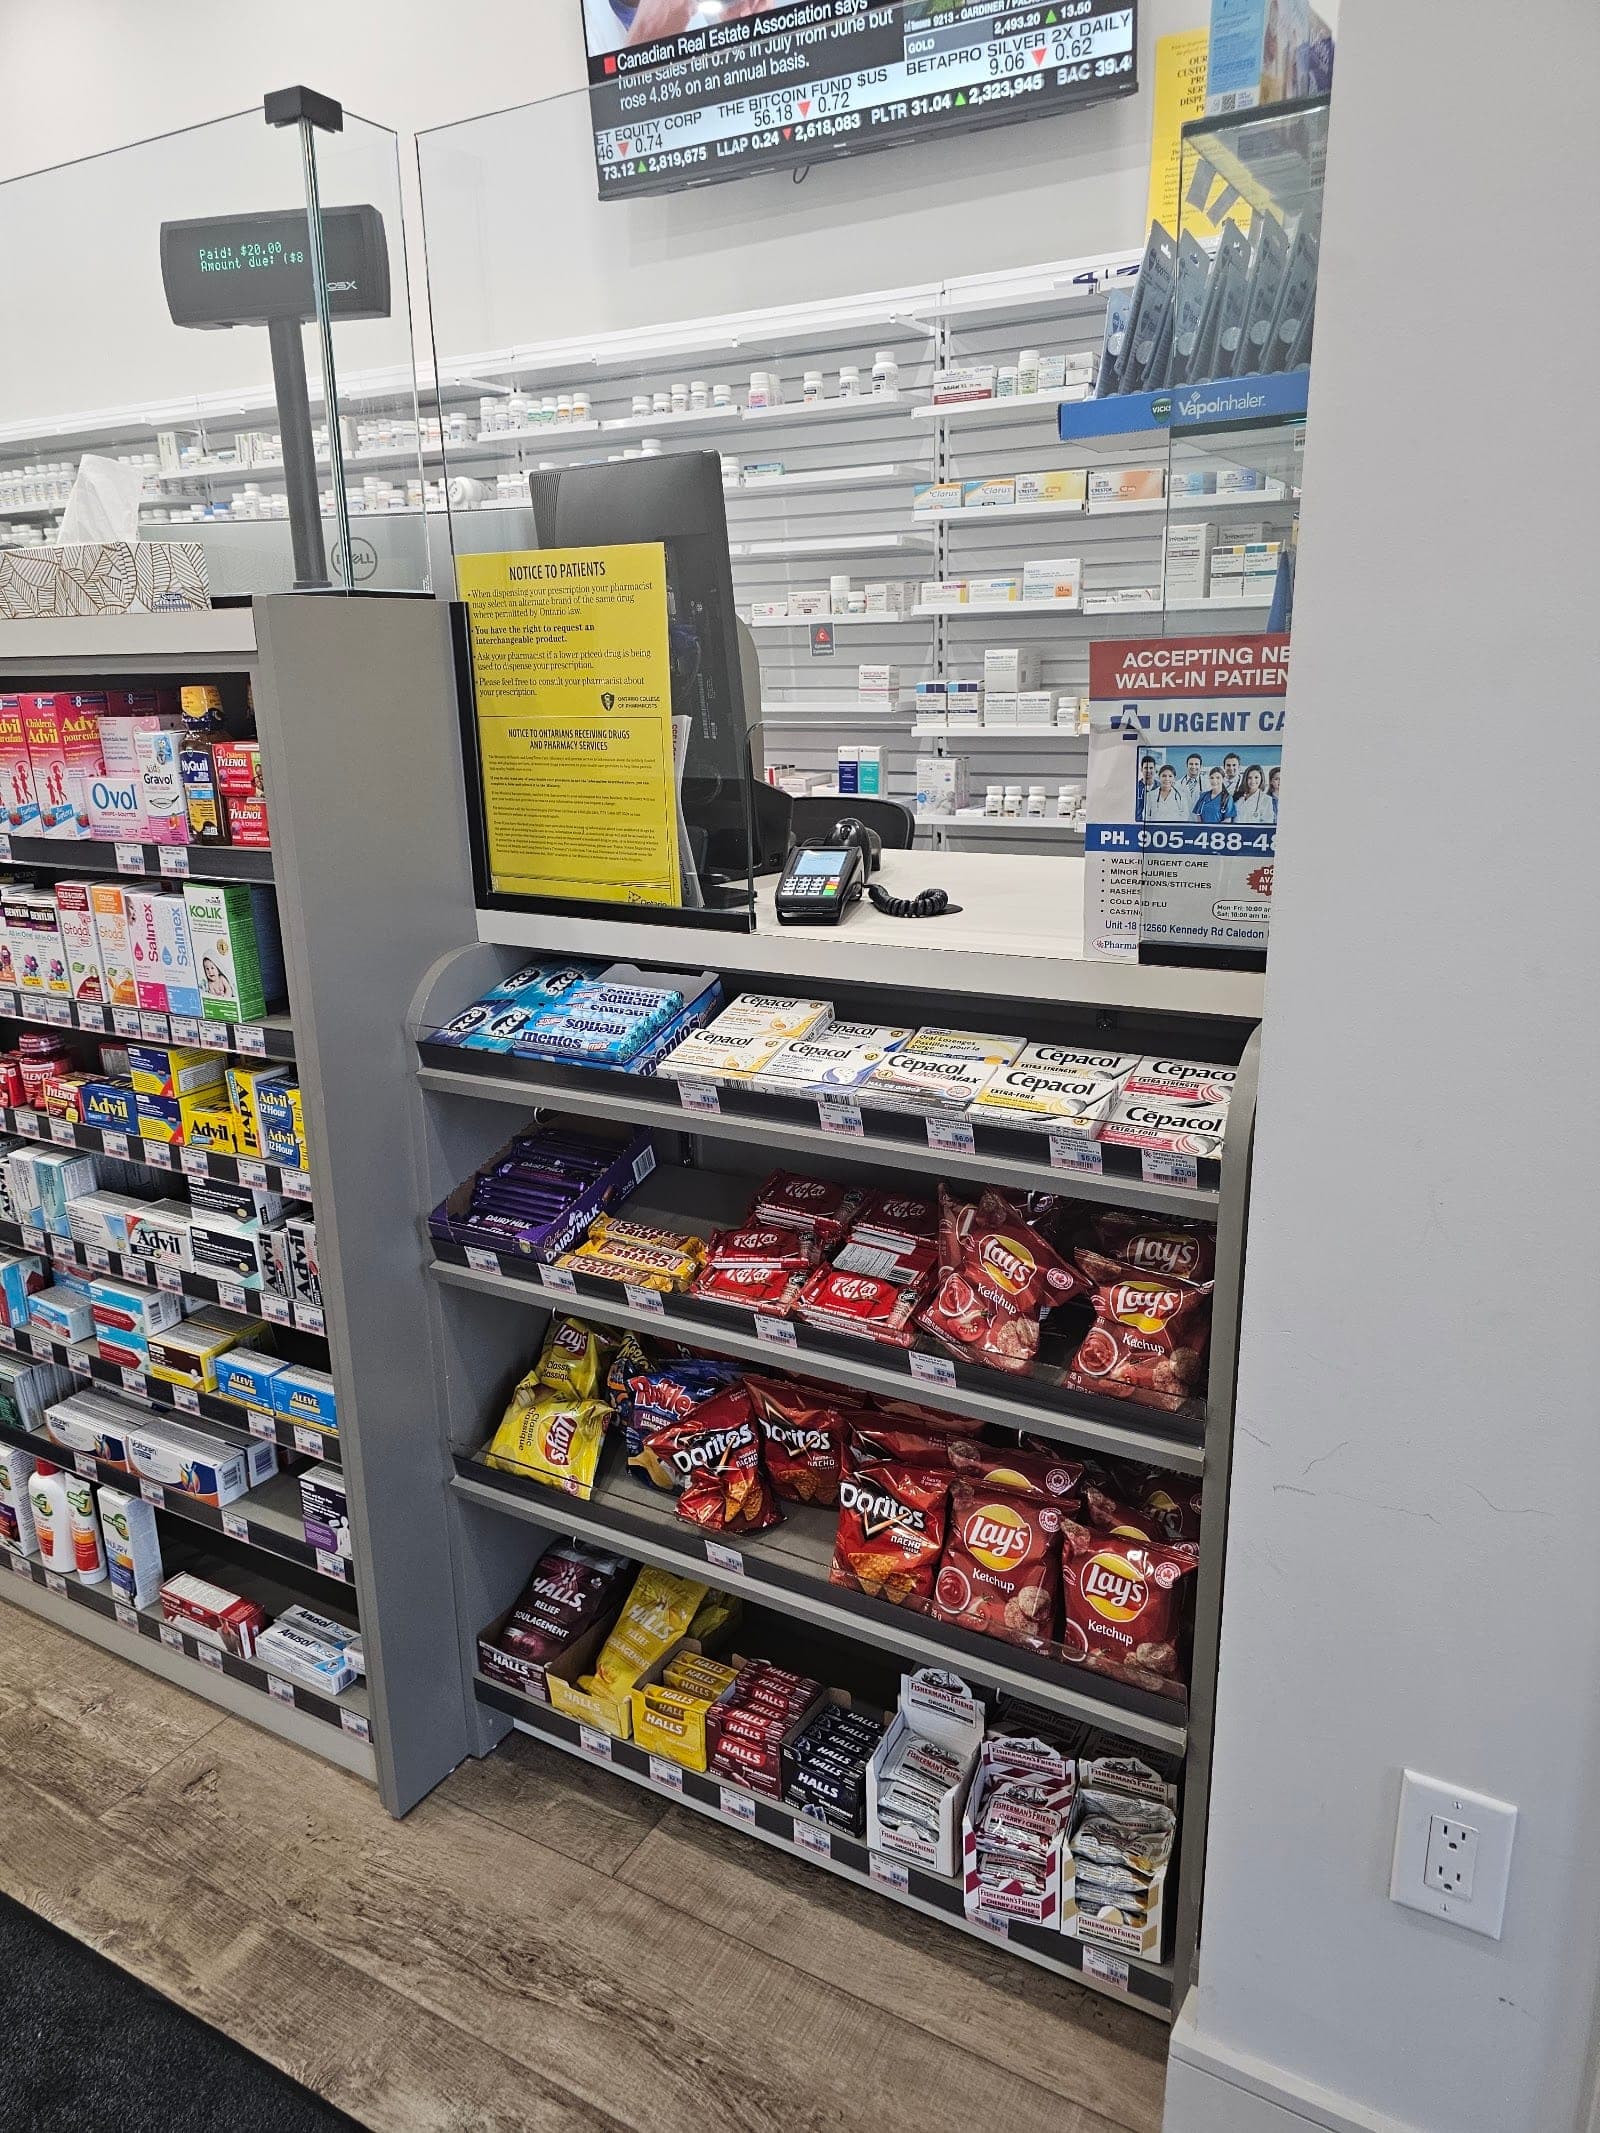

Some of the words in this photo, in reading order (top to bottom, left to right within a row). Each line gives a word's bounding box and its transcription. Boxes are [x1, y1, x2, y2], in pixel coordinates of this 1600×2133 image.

[993, 13, 1041, 36] 2,493.20
[1060, 2, 1092, 19] 13.50
[617, 46, 675, 71] Canadian
[678, 36, 707, 56] Real
[710, 25, 750, 47] Estate
[753, 8, 832, 37] Association
[835, 0, 868, 17] says
[618, 72, 652, 91] home
[654, 61, 687, 82] sales
[690, 55, 709, 74] fell
[712, 46, 746, 68] 0.7%
[750, 41, 763, 58] in
[765, 34, 792, 56] July
[795, 27, 828, 48] from
[831, 17, 866, 39] June
[869, 8, 894, 27] but
[908, 39, 935, 55] GOLD
[615, 121, 662, 142] EQUITY
[664, 111, 702, 131] CORP
[717, 102, 745, 119] THE
[748, 89, 807, 113] BITCOIN
[811, 77, 851, 101] FUND
[856, 68, 888, 89] $US
[906, 47, 982, 77] BETAPRO
[987, 32, 1046, 58] SILVER
[1052, 24, 1074, 43] 2X
[1080, 11, 1132, 36] DAILY
[620, 90, 647, 110] rose
[649, 81, 682, 104] 4.8%
[685, 77, 701, 94] on
[704, 73, 721, 90] an
[723, 60, 767, 87] annual
[769, 53, 810, 76] basis.
[635, 134, 663, 154] 0.74
[753, 105, 793, 128] 56.18
[818, 92, 851, 114] 0.72
[989, 52, 1026, 77] 9.06
[1055, 37, 1093, 62] 0.62
[602, 162, 636, 182] 73.12
[717, 138, 749, 157] LLAP
[751, 130, 780, 150] 0.24
[870, 102, 908, 122] PLTR
[911, 92, 952, 117] 31.04
[1056, 62, 1092, 86] BAC
[200, 247, 233, 261] Paid:
[240, 241, 282, 257] $20.00
[200, 257, 242, 273] Amount
[248, 256, 275, 269] due:
[284, 251, 304, 264] ($8
[1178, 392, 1266, 419] VapoInhaler
[509, 565, 543, 581] NOTICE
[545, 563, 558, 579] TO
[560, 561, 606, 578] PATIENTS
[1122, 647, 1254, 669] ACCEPTING
[1115, 669, 1206, 690] WALK-IN
[1158, 711, 1250, 733] URGENT
[28, 729, 59, 744] Advil
[508, 728, 529, 738] NOTICE
[530, 728, 538, 738] TO
[539, 729, 574, 739] ONTARIANS
[574, 729, 607, 739] RECEIVING
[608, 730, 630, 739] DRUGS
[530, 741, 543, 750] AND
[544, 741, 578, 750] PHARMACY
[579, 741, 608, 751] SERVICES
[181, 760, 209, 775] NyQuil
[216, 756, 248, 768] TYLENOL
[144, 773, 173, 785] Gravol
[92, 782, 139, 811] Ovol
[230, 808, 262, 820] TYLENOL
[1100, 829, 1130, 846] PH.
[1110, 868, 1138, 876] MINOR
[1141, 870, 1179, 878] NJURIES
[30, 910, 55, 922] BENYLIN
[189, 904, 222, 920] KOLIK
[64, 922, 91, 937] Stodal
[143, 903, 160, 963] Salinex
[171, 907, 188, 967] Salinex
[1105, 920, 1123, 930] Unit
[1124, 921, 1137, 930] -18
[1143, 923, 1167, 933] 12560
[1169, 925, 1209, 938] Kennedy
[1211, 926, 1223, 937] Rd
[1226, 927, 1265, 939] Caledon
[599, 992, 660, 1008] mentos
[565, 1018, 627, 1035] mentos
[521, 1030, 583, 1050] mentos
[1021, 1062, 1042, 1072] EXTRA
[1043, 1065, 1078, 1075] STRENGTH
[46, 1085, 76, 1102] TYLENOL
[259, 1091, 288, 1108] Advil
[88, 1095, 129, 1119] Advil
[236, 1083, 258, 1148] Advil
[260, 1103, 268, 1113] 12
[268, 1105, 286, 1118] Hour
[191, 1120, 229, 1141] Advil
[1110, 1124, 1159, 1137] EXTRA-FORT
[137, 1226, 181, 1256] Advil
[544, 1230, 576, 1264] DAIRY
[574, 1203, 601, 1235] MILK
[984, 1236, 1032, 1283] Lay's
[1135, 1236, 1196, 1272] Lay's
[977, 1282, 1018, 1315] Ketchup
[1116, 1286, 1179, 1318] Lay's
[553, 1323, 588, 1353] Lay's
[1122, 1332, 1166, 1354] Ketchup
[229, 1371, 256, 1389] ALEVE
[291, 1390, 319, 1408] ALEVE
[544, 1413, 577, 1466] Lay's
[672, 1423, 754, 1474] Doritos
[839, 1481, 926, 1531] Doritos
[890, 1534, 923, 1550] NACHO
[967, 1515, 1029, 1557] Lay's
[972, 1567, 1015, 1593] Ketchup
[1088, 1563, 1145, 1606] Lay's
[532, 1577, 587, 1610] HALLS
[534, 1599, 561, 1616] RELIEF
[299, 1609, 331, 1630] Anusol
[330, 1622, 350, 1638] Plus
[513, 1610, 570, 1639] SOULAGEMENT
[1087, 1618, 1134, 1646] Ketchup
[492, 1653, 530, 1677] HALLS
[911, 1682, 951, 1702] FISHERMAN'S
[949, 1695, 974, 1711] FRIEND
[645, 1712, 684, 1735] HALLS
[731, 1709, 766, 1726] HALLS
[721, 1740, 762, 1765] HALLS
[817, 1745, 852, 1766] HALLS
[797, 1771, 840, 1799] HALLS
[993, 1800, 1033, 1819] FISHERMAN'S
[1031, 1808, 1056, 1825] FRIEND
[1000, 1813, 1021, 1826] CHERRY
[1026, 1820, 1046, 1832] CERISE
